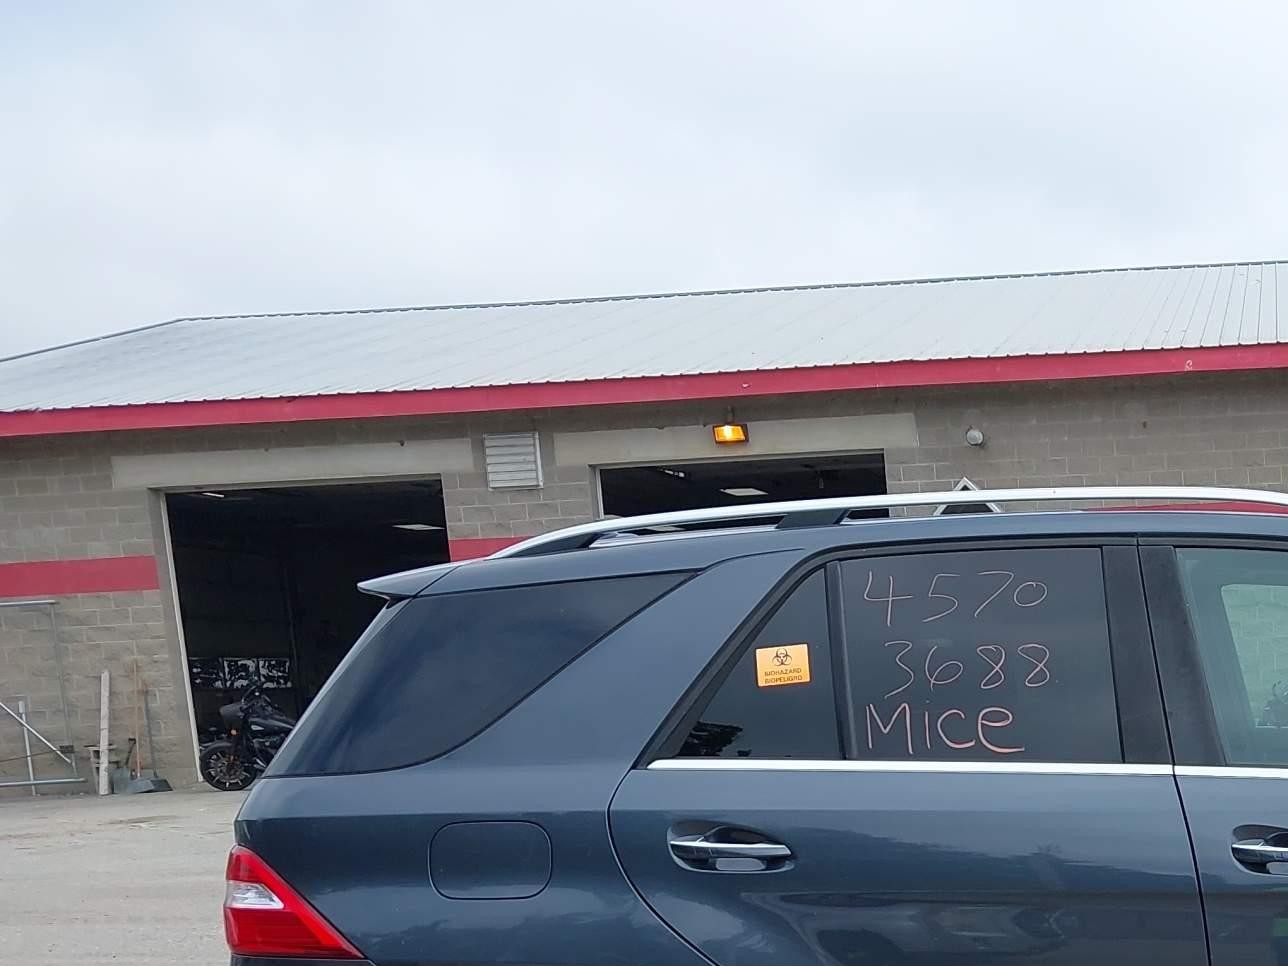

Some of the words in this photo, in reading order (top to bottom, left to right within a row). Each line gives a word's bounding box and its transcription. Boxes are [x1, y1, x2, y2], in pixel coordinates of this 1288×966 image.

[863, 570, 1048, 627] 4570
[764, 667, 802, 677] BIOHAZARD
[883, 640, 1051, 699] 3688
